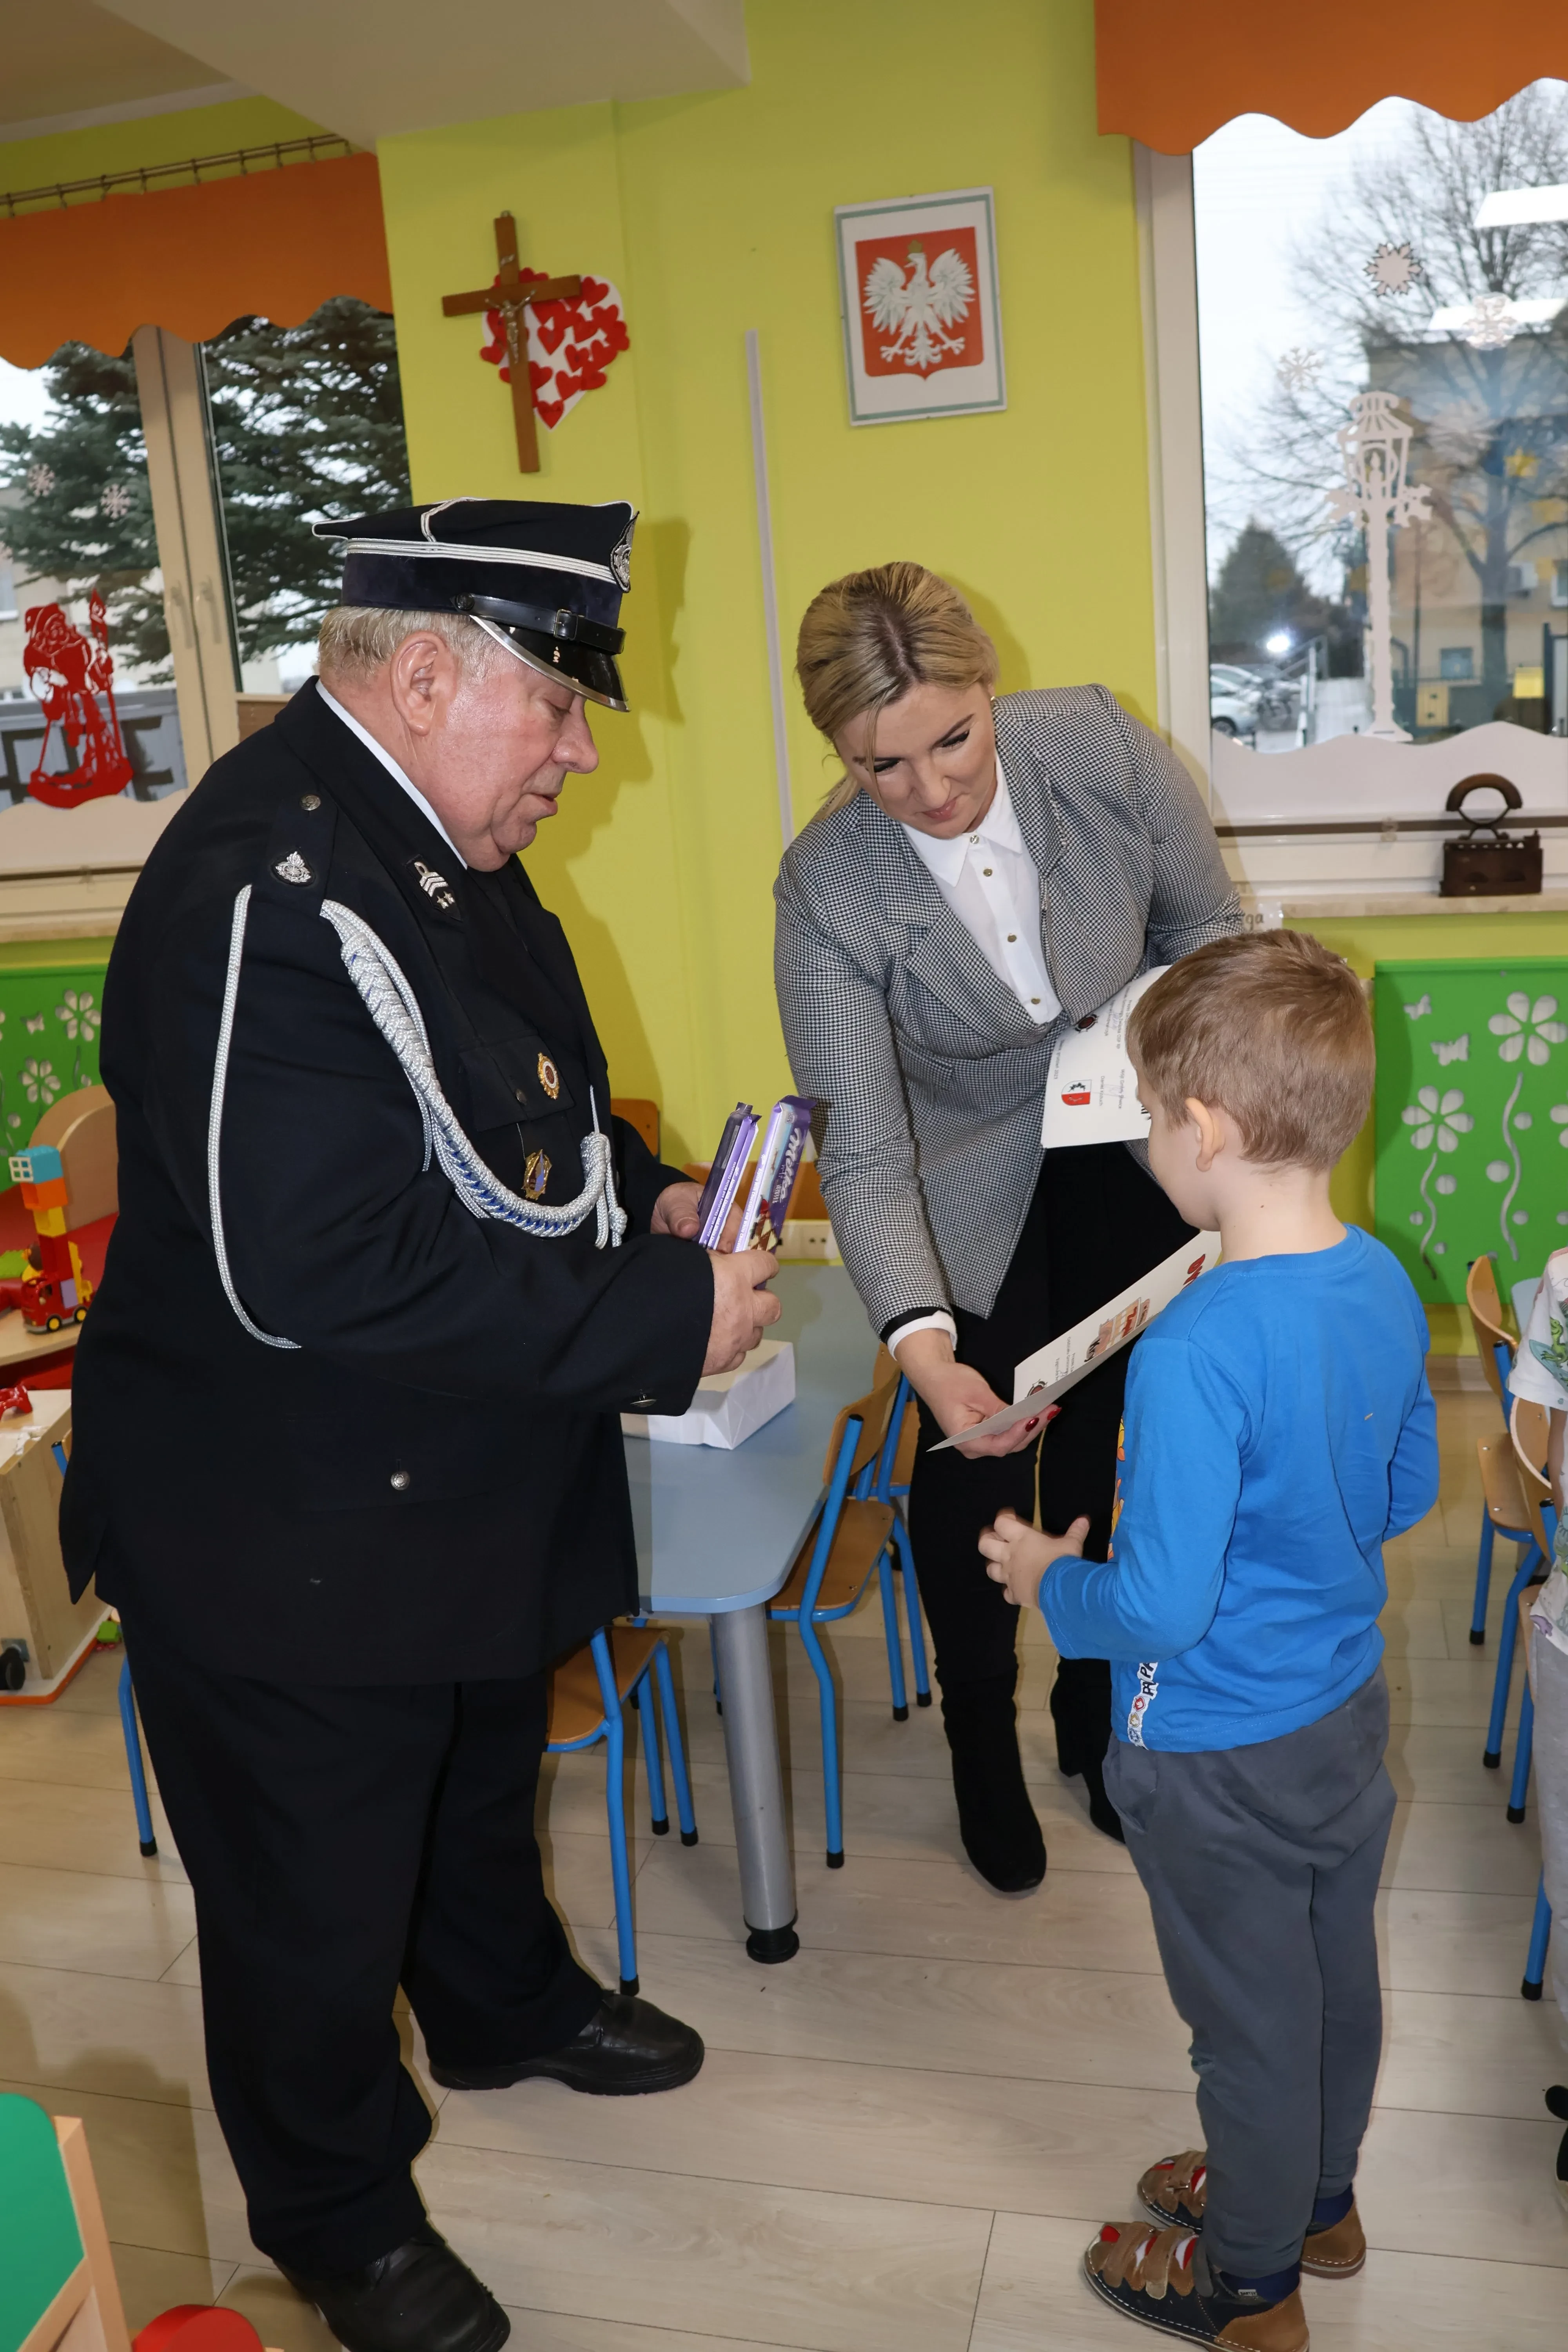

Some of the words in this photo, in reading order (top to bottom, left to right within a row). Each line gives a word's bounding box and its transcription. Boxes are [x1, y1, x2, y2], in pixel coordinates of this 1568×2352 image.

[780, 1127, 801, 1203] Milka
[715, 1198, 723, 1216] Chocolate
[728, 1161, 736, 1179] Chocolate
[747, 1191, 756, 1212] Chocolate
[719, 1199, 728, 1217] Chocolate
